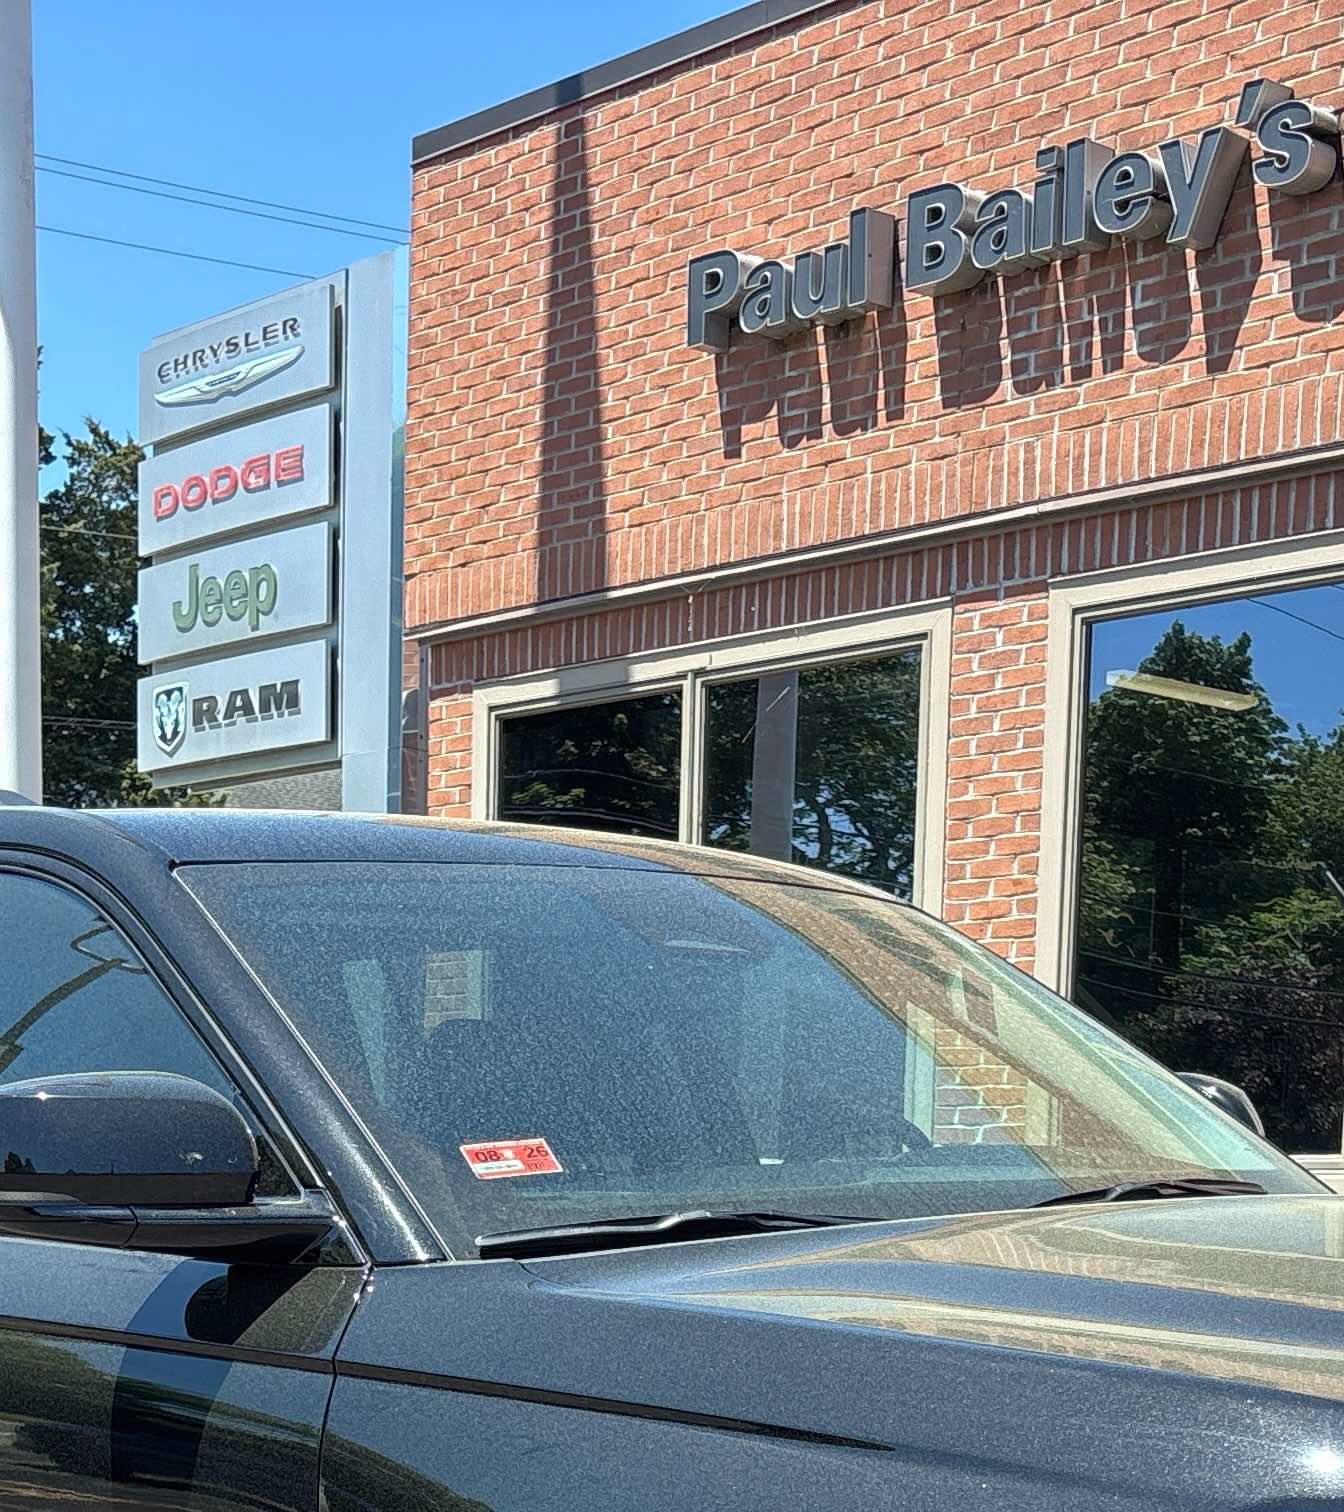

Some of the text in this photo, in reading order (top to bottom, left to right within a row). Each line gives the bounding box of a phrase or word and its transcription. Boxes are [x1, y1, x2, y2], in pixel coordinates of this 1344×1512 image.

[687, 78, 1326, 352] Paul Bailey's
[157, 316, 301, 382] CHRYSLER
[152, 444, 305, 519] DODGE
[172, 562, 278, 631] Jeep
[192, 679, 302, 728] RAM
[475, 1146, 549, 1162] 08 26
